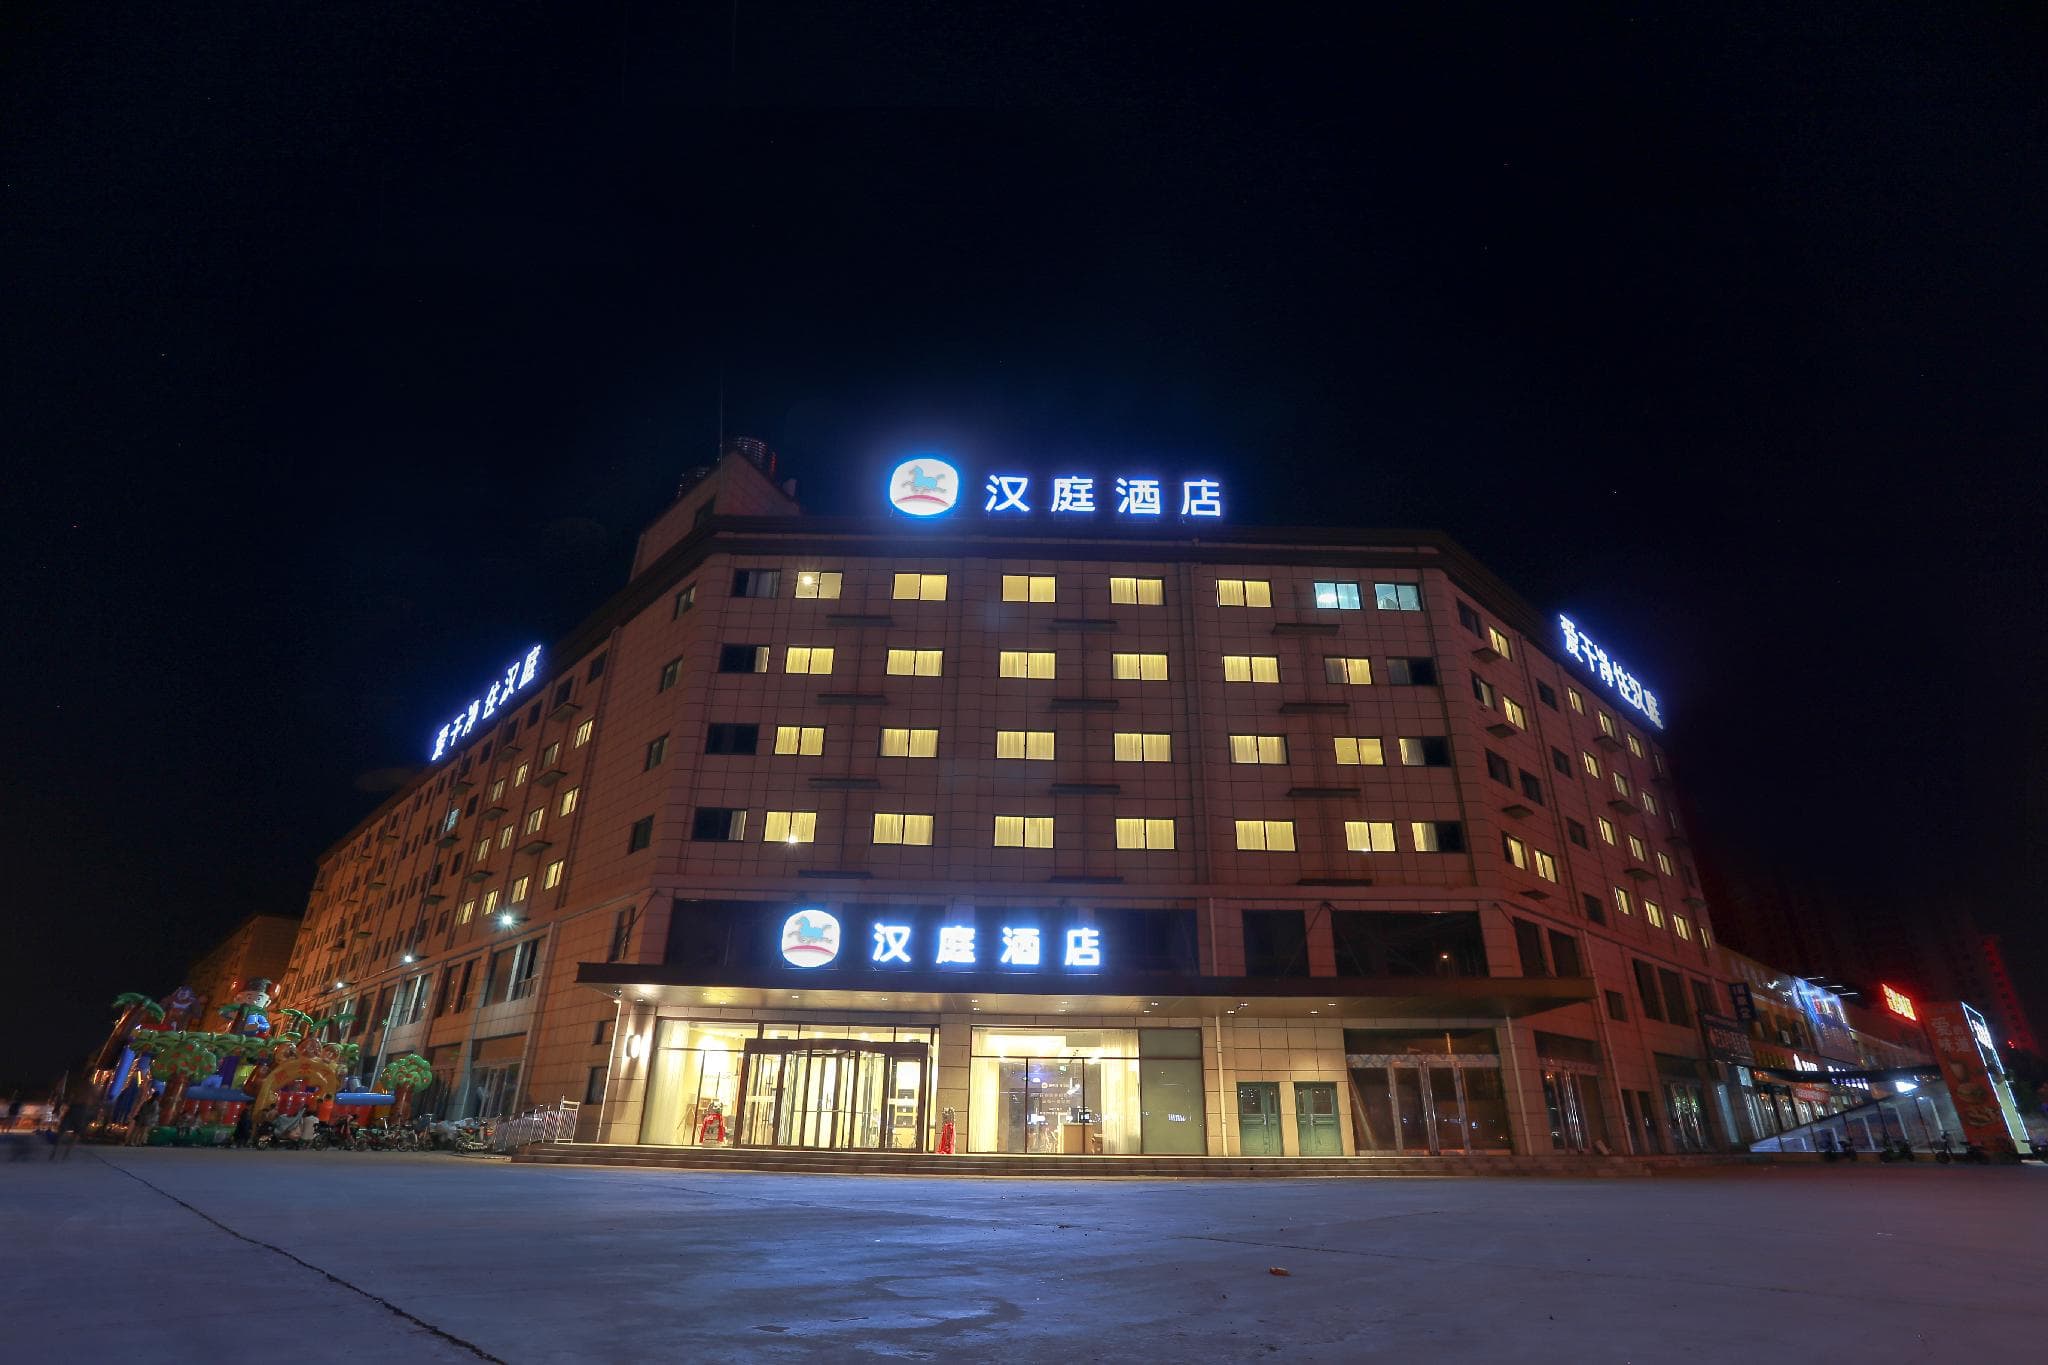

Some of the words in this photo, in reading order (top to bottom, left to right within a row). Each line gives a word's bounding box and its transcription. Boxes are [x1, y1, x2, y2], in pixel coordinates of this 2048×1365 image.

[985, 474, 1221, 517] 汉庭酒店
[872, 922, 1101, 966] 汉庭酒店
